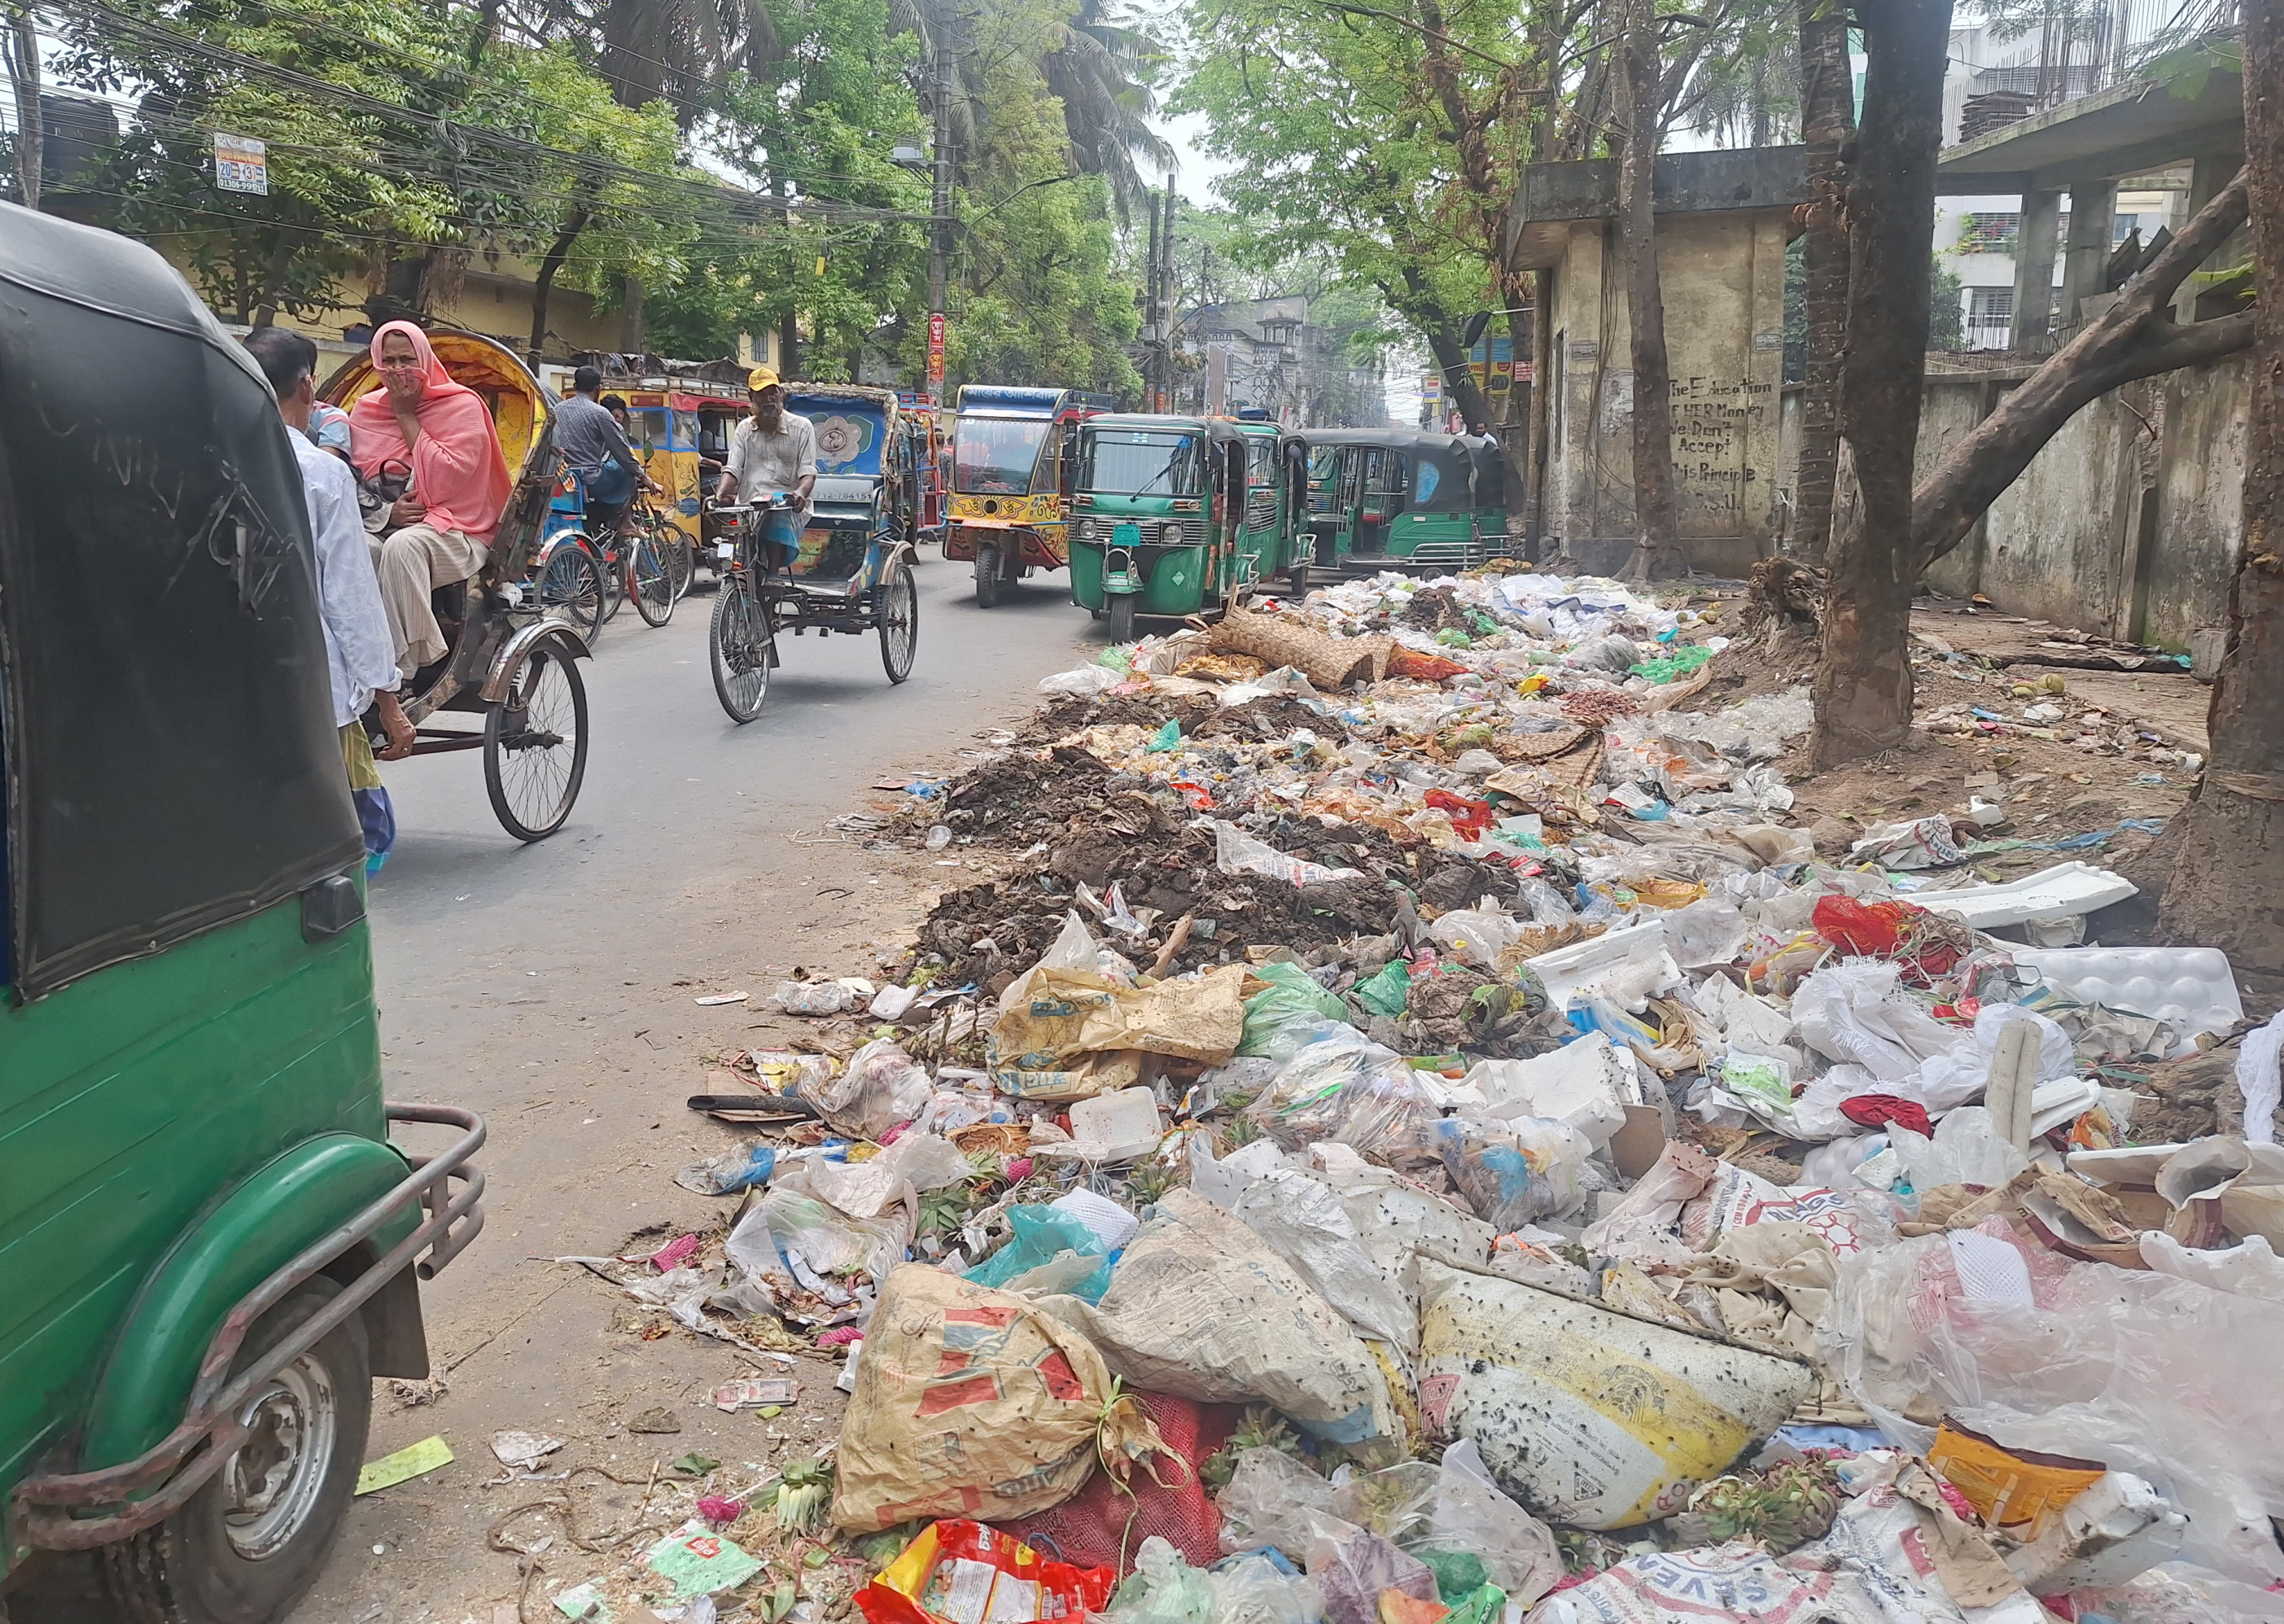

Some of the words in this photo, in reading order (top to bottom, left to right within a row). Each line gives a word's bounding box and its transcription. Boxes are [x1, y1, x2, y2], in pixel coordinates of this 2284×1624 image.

[1690, 376, 1772, 399] Education
[1717, 403, 1764, 422] Money
[1678, 438, 1732, 461] Accept
[1627, 1553, 1768, 1605] SEVEN
